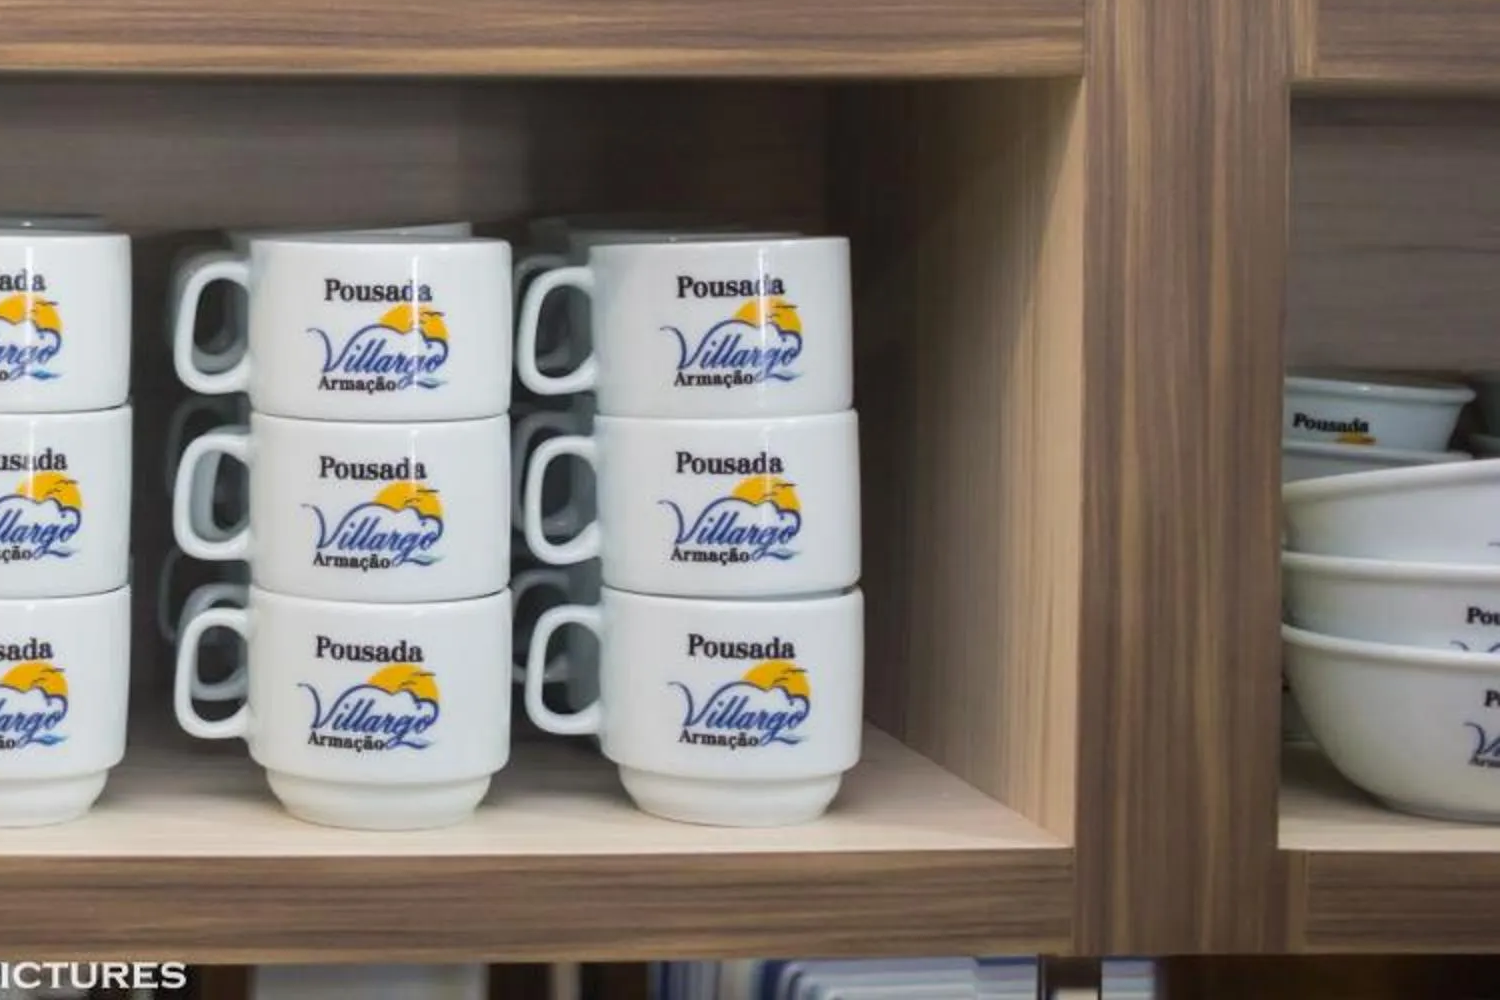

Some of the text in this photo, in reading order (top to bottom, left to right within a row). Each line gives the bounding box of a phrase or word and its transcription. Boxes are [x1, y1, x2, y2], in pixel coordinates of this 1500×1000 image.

[319, 375, 397, 394] Armação
[675, 370, 753, 387] Armação
[1292, 412, 1369, 434] Pousada
[319, 455, 428, 482] Pousada
[675, 450, 785, 476] Pousada
[313, 552, 390, 570] Armação
[671, 547, 749, 564] Armação
[315, 634, 425, 664] Pousada
[687, 633, 797, 661] Pousada
[307, 731, 386, 750] Armação
[680, 730, 758, 748] Armação
